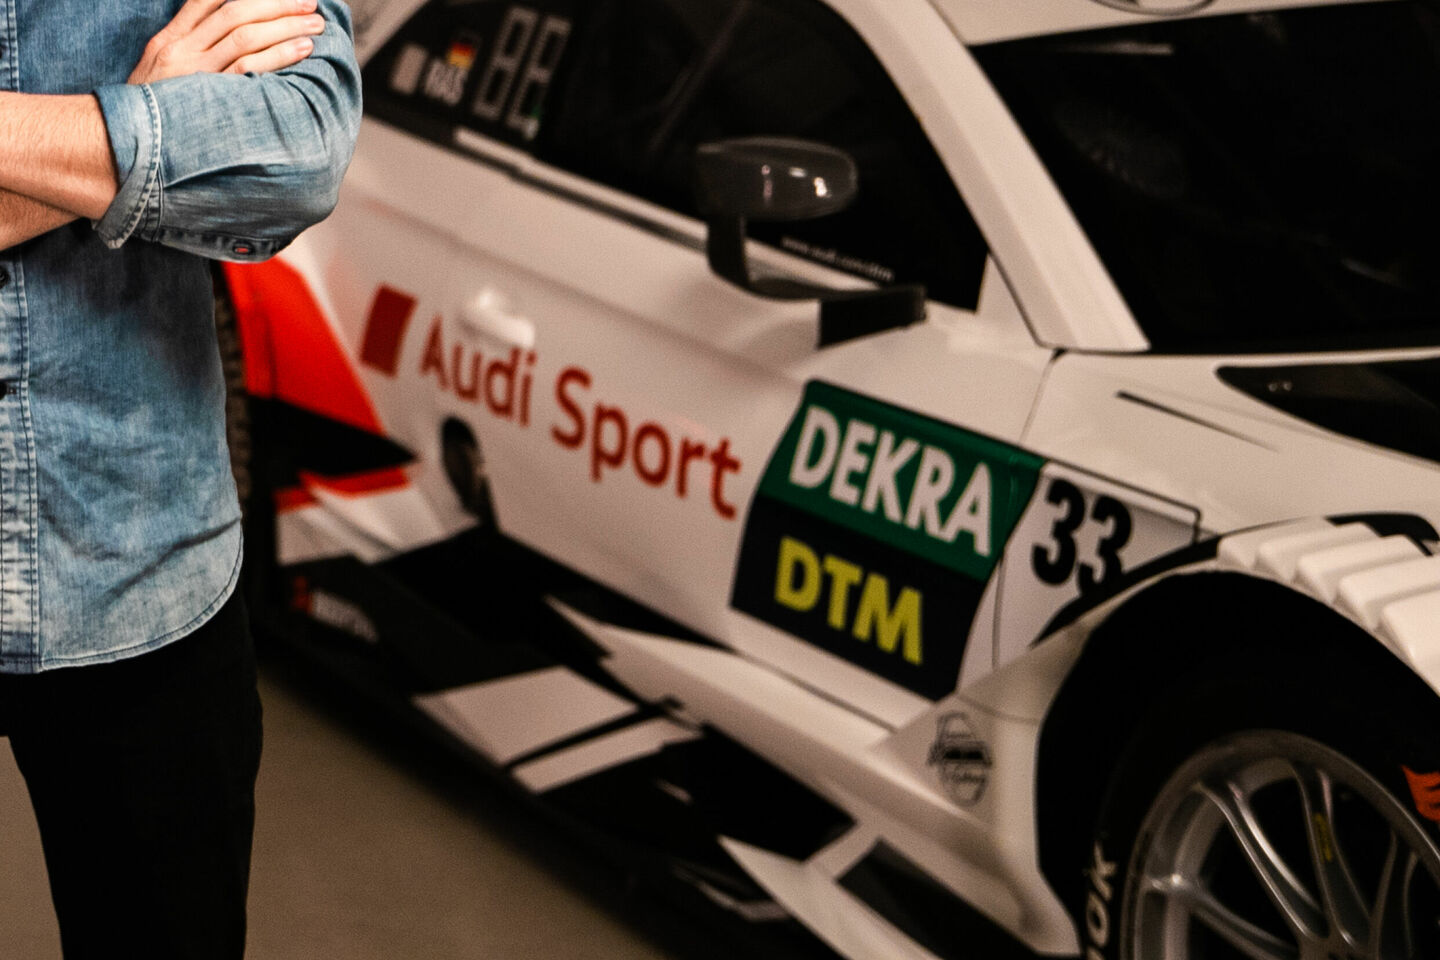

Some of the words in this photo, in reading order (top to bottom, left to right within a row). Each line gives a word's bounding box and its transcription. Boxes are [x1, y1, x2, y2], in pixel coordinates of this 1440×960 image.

[420, 313, 538, 428] Audi
[550, 366, 741, 520] Sport
[789, 404, 992, 559] DEKRA
[773, 535, 924, 667] DTM
[1030, 477, 1132, 602] 33
